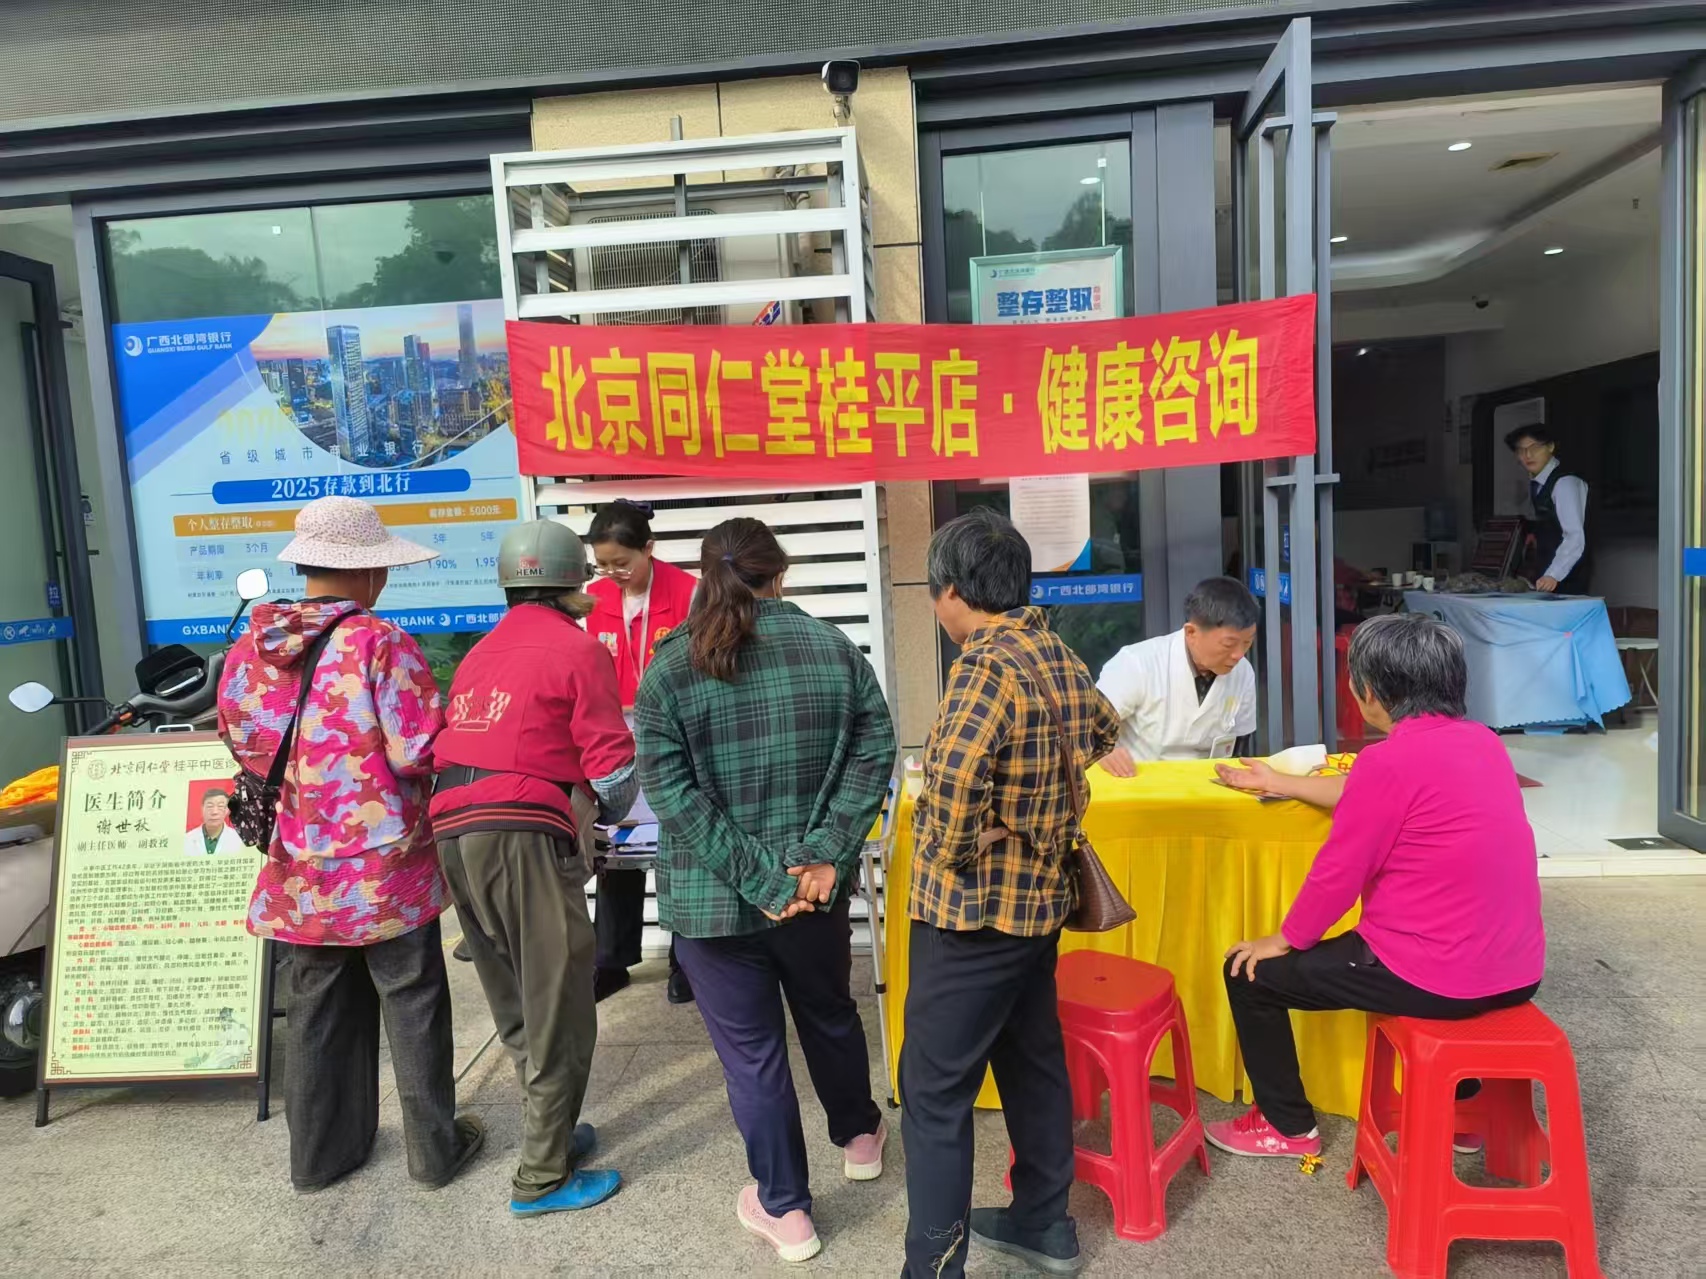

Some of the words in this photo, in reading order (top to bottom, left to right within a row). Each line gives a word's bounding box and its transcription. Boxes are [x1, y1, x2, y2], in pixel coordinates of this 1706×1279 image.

[997, 287, 1092, 316] 整存整取
[147, 332, 231, 347] 广西北部湾银行
[541, 328, 1259, 458] 北京同仁堂桂平店·健康咨询
[219, 440, 424, 465] 省级城市商业银行
[271, 472, 411, 499] 2025存款到北行
[189, 544, 225, 556] 产品期限
[245, 542, 269, 553] 3个月
[433, 533, 447, 544] 3年
[480, 531, 495, 541] 5年
[196, 570, 224, 580] 年利率
[427, 559, 457, 570] 1.90%
[475, 556, 500, 568] 1.95
[1047, 582, 1134, 597] 广西北部湾银行
[110, 758, 240, 777] 北京同仁堂桂平中医诊
[84, 789, 168, 812] 医生简介
[96, 817, 151, 835] 谢世秋
[77, 839, 128, 852] 副主任医师
[138, 838, 169, 849] 副教授
